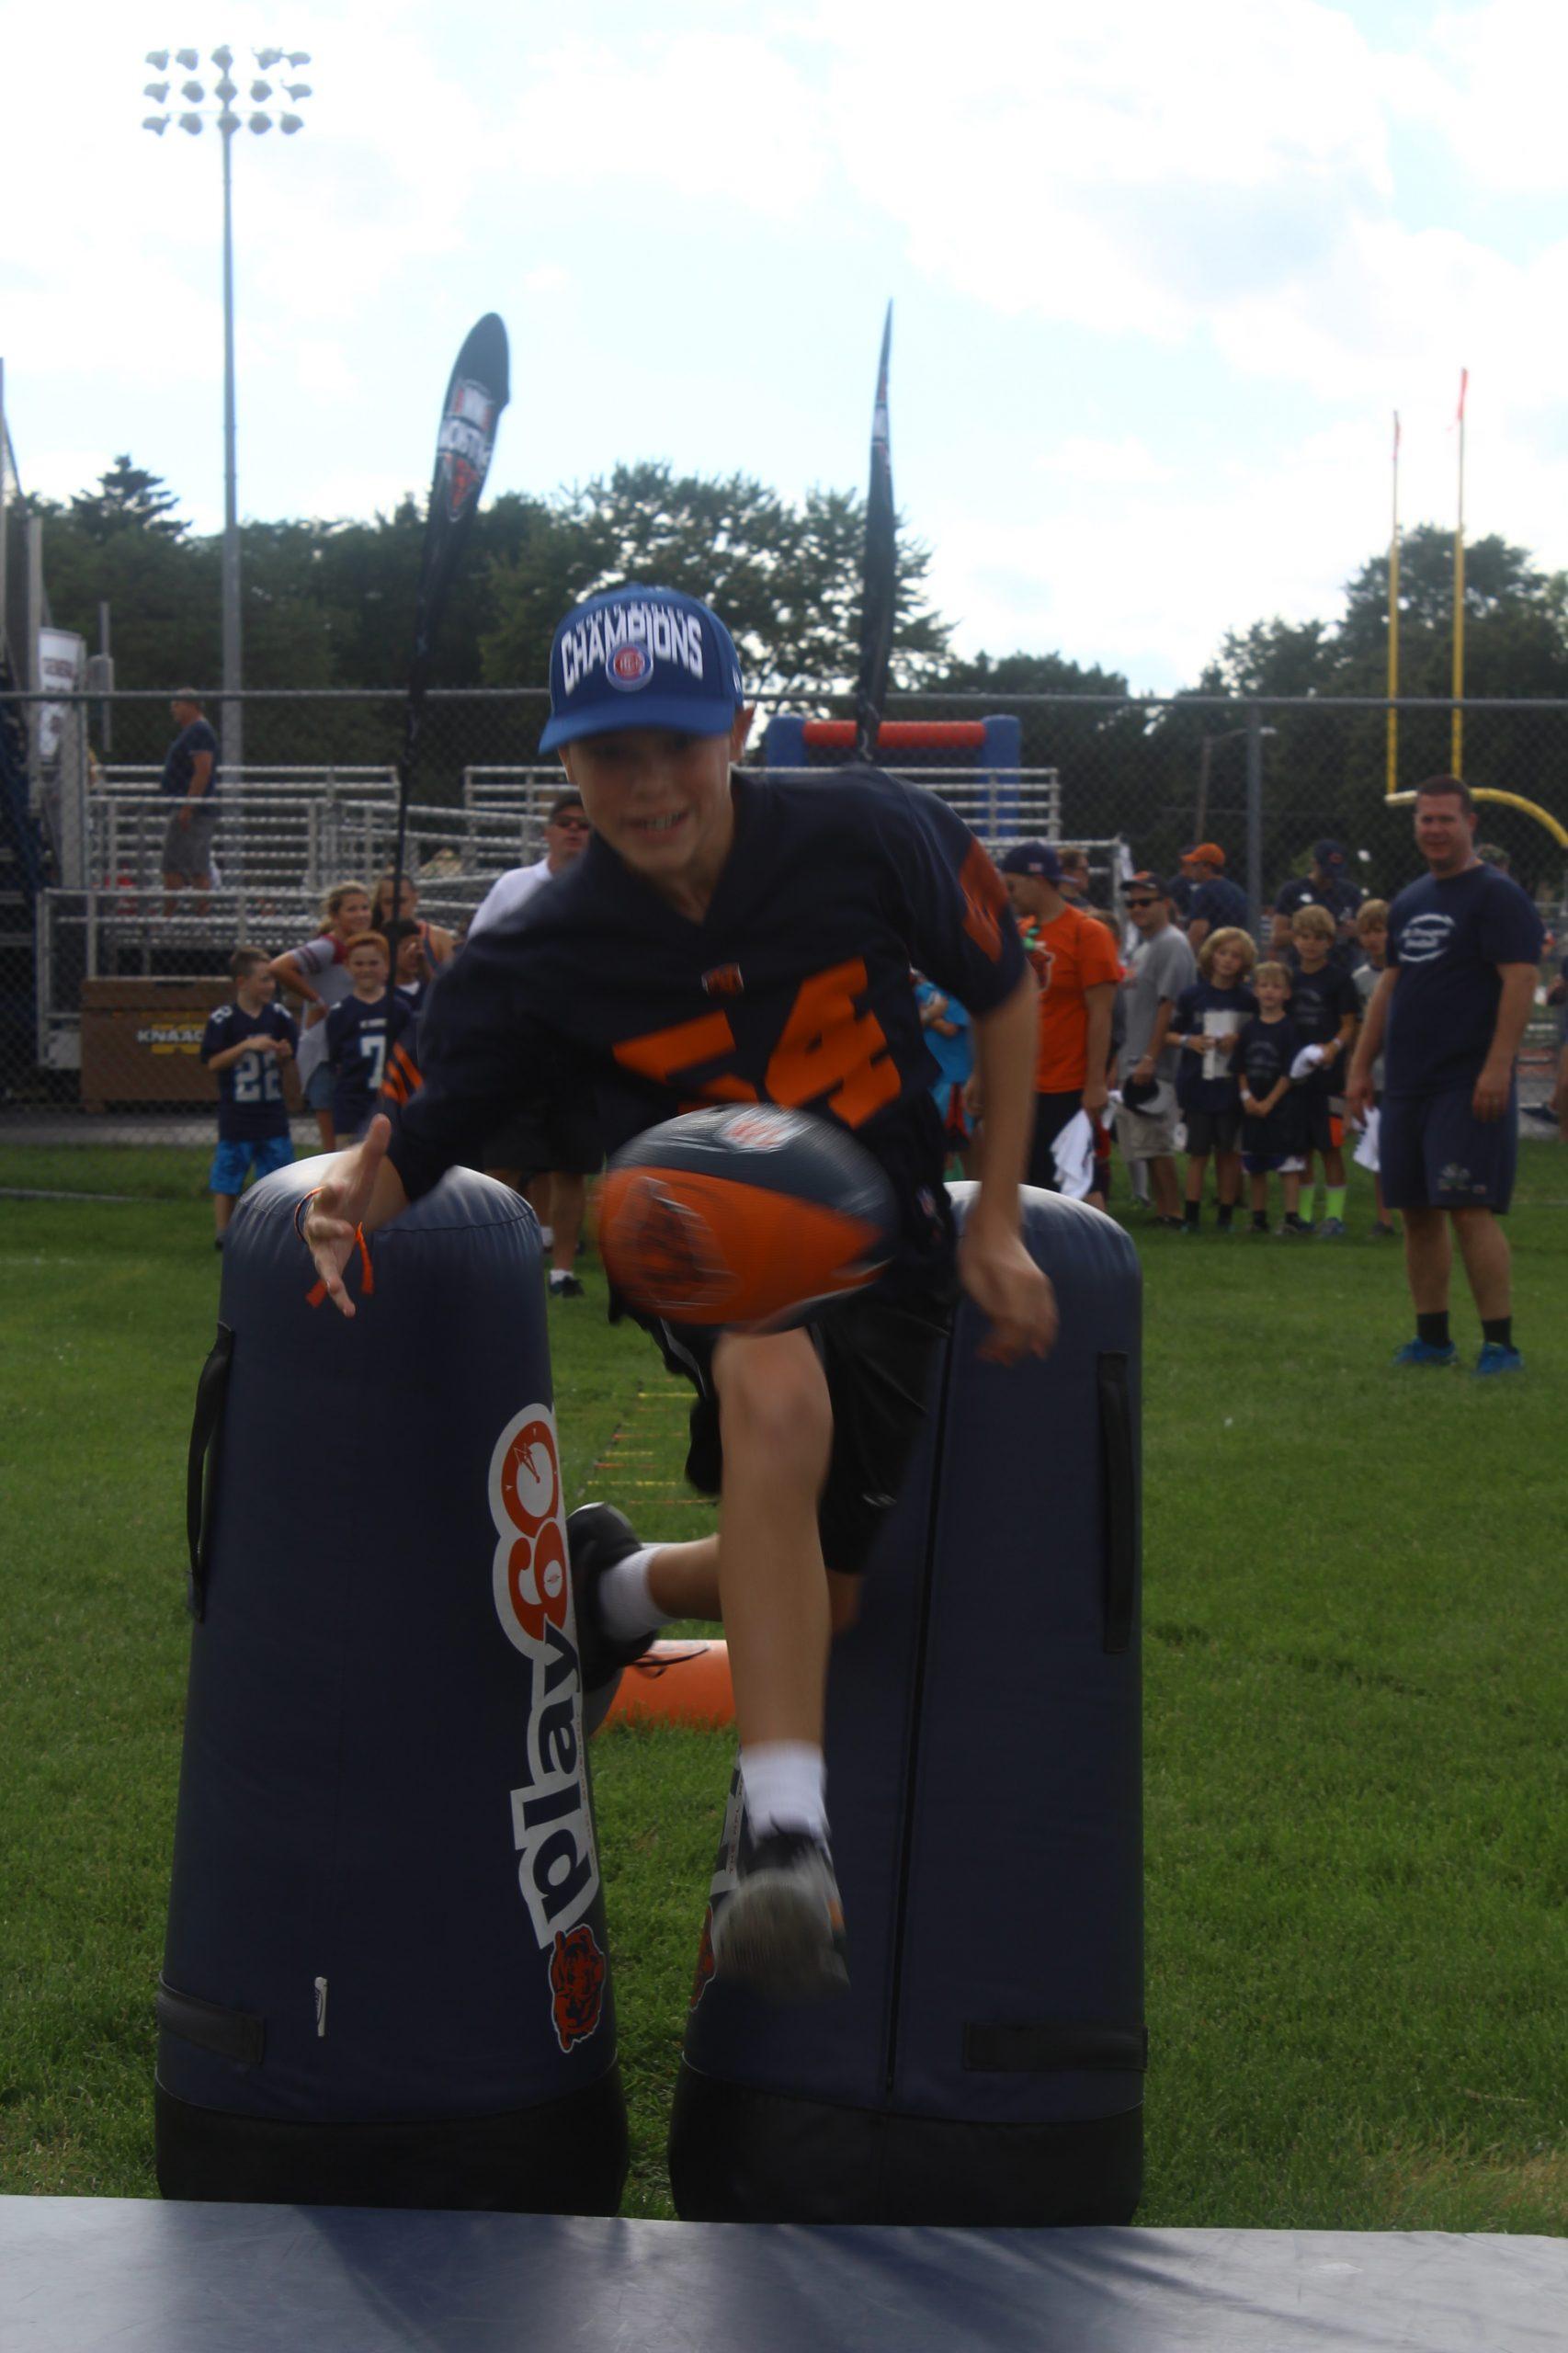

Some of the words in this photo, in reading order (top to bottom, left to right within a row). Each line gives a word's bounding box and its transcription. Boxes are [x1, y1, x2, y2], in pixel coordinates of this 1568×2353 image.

[561, 608, 703, 696] CHAMPIONS
[500, 1420, 568, 1643] 60
[523, 1613, 589, 1919] play
